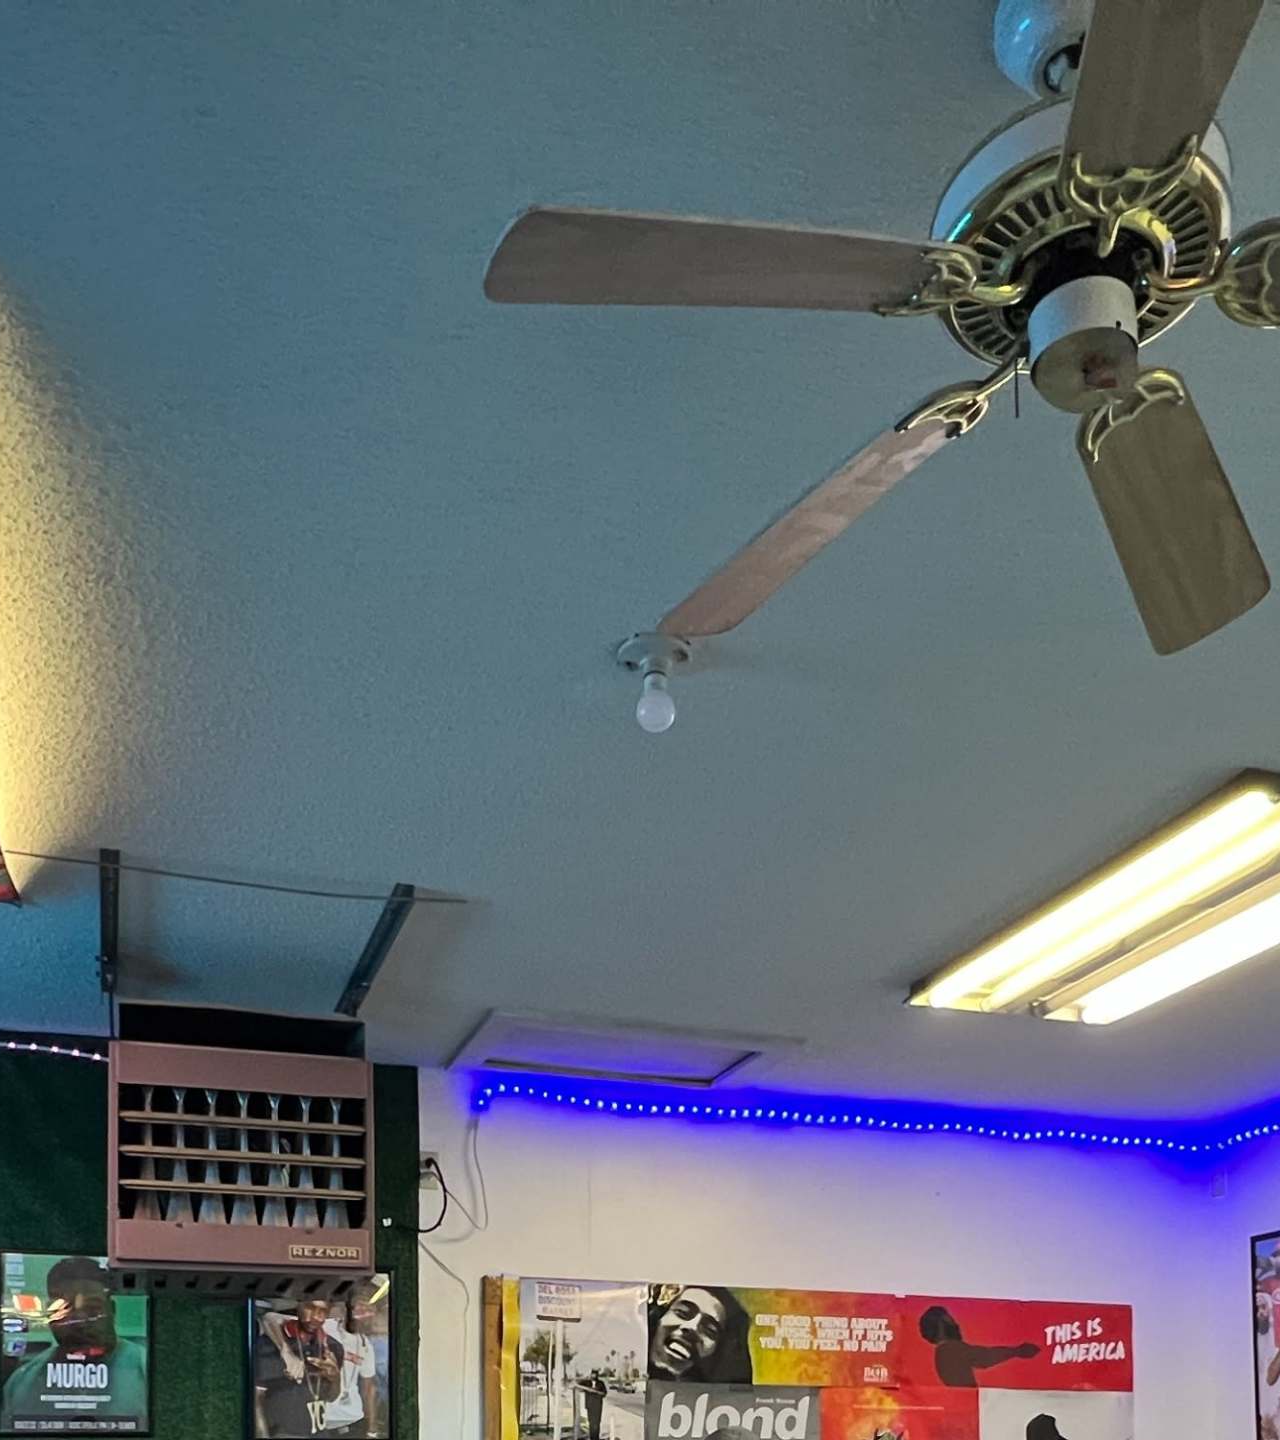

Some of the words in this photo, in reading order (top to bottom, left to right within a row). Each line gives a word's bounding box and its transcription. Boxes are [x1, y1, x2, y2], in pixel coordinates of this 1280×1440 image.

[292, 1247, 358, 1259] REZNOR
[1044, 1321, 1082, 1346] THIS
[1086, 1317, 1103, 1338] IS
[1051, 1340, 1125, 1365] AMERICA
[46, 1363, 108, 1389] MURGO
[657, 1391, 810, 1440] blond
